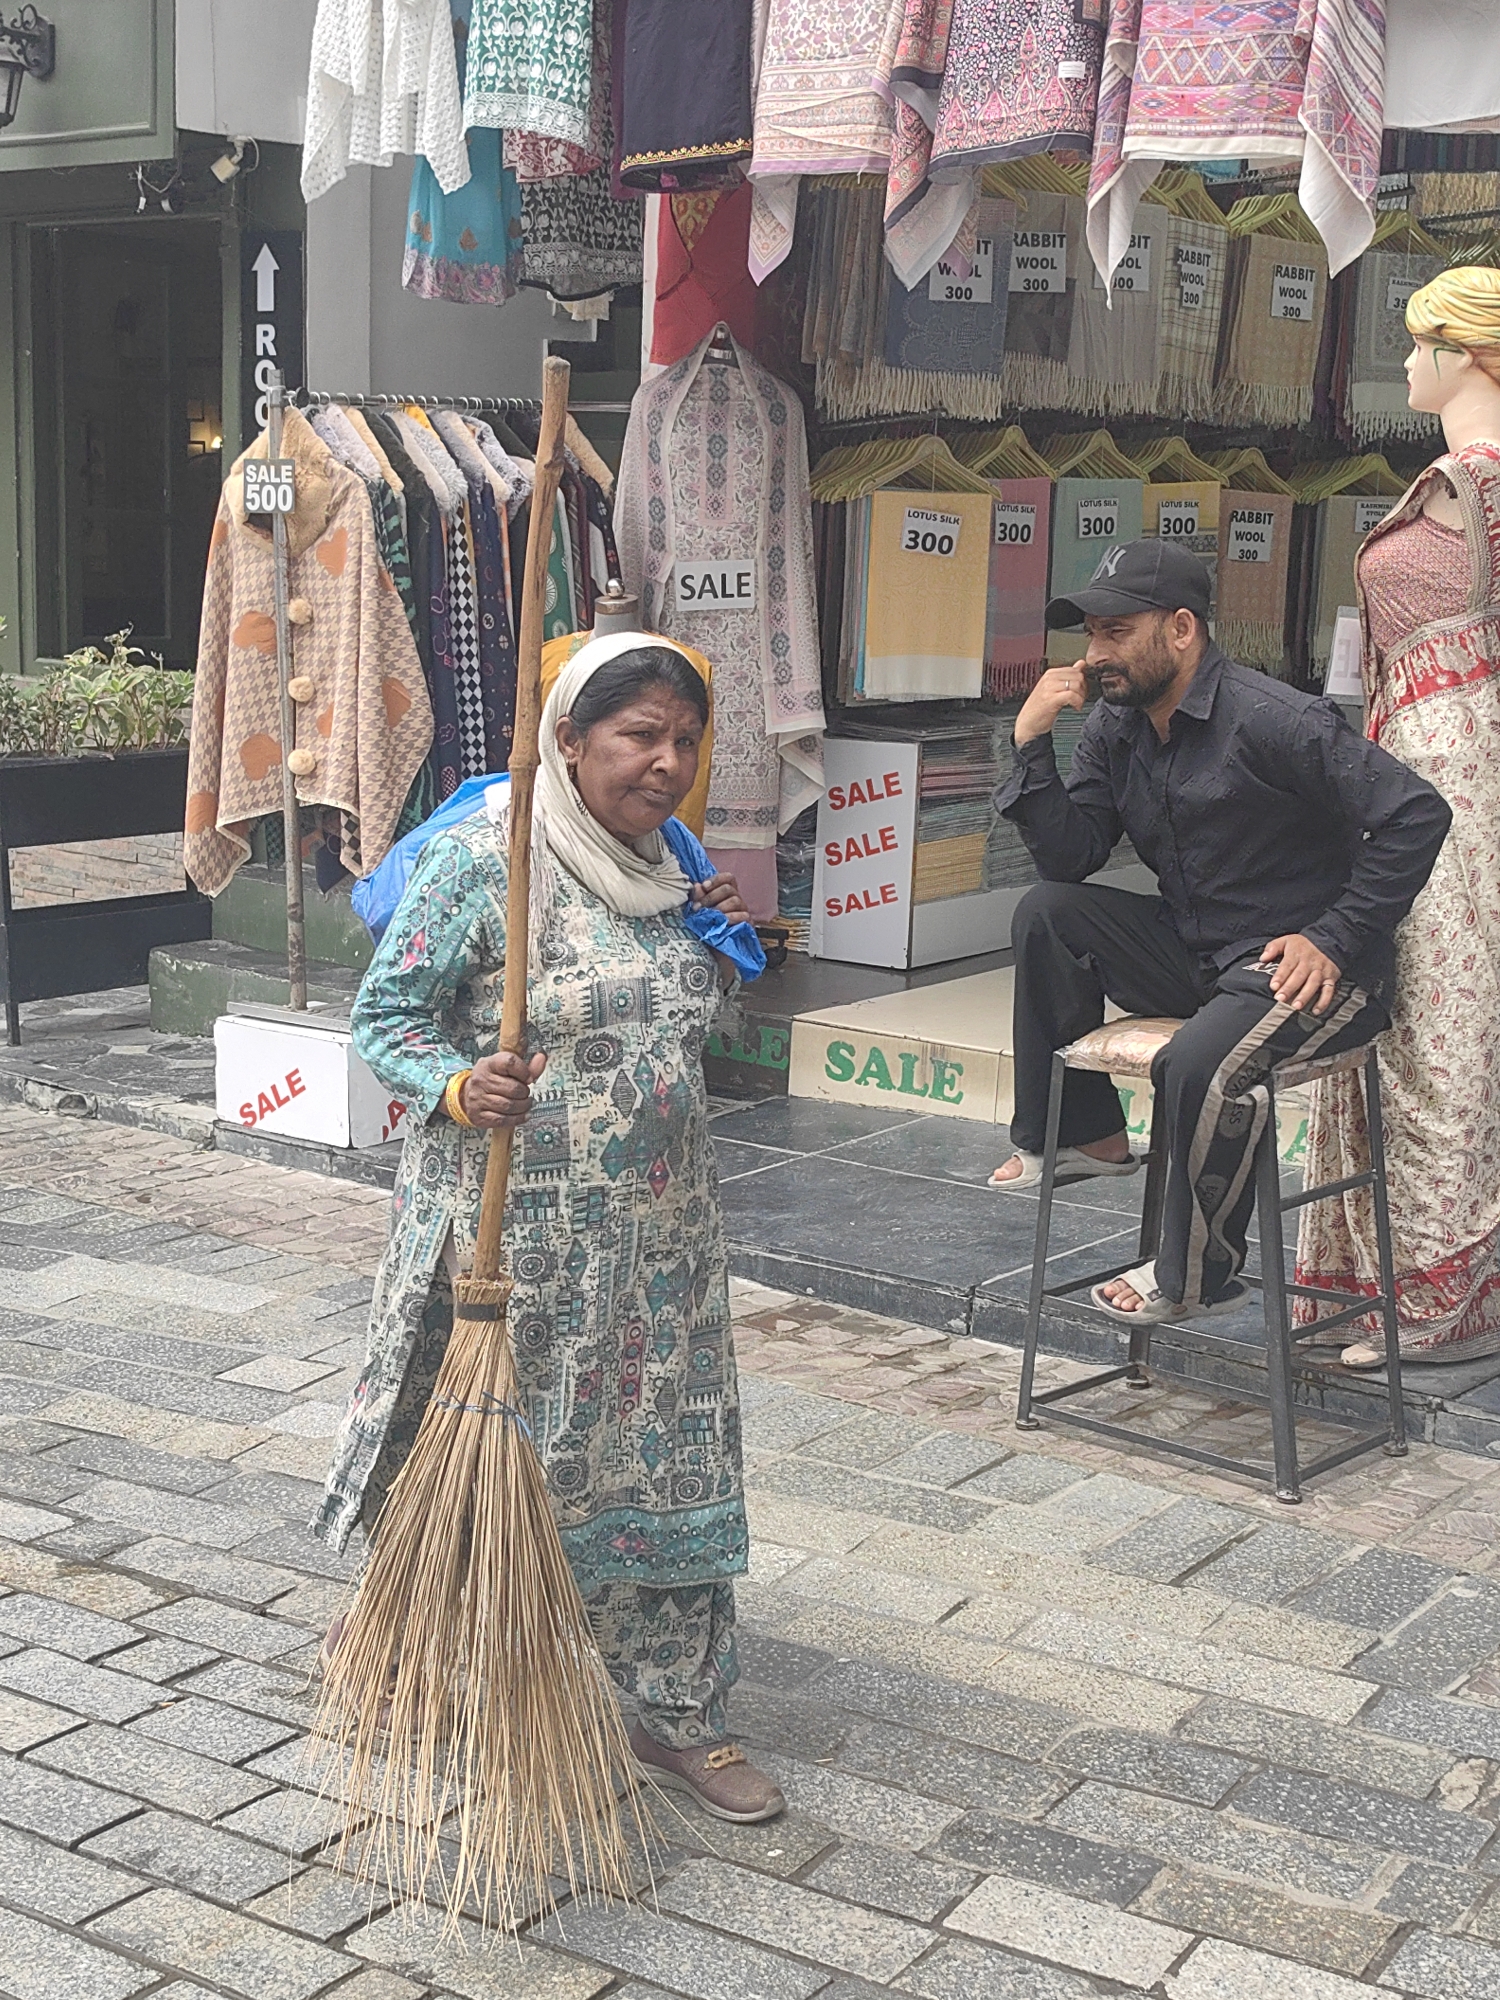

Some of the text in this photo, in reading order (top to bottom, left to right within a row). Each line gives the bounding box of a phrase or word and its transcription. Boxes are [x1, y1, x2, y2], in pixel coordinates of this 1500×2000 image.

[1016, 257, 1058, 270] WOOL
[1117, 257, 1142, 269] OOL
[1178, 248, 1211, 267] RABBIT
[1181, 272, 1205, 286] WOOL
[1275, 264, 1316, 282] RABBIT
[1023, 278, 1049, 291] 300
[945, 286, 973, 300] 300
[1184, 292, 1200, 305] 300
[1279, 286, 1308, 300] WOOL
[1393, 297, 1408, 309] 35
[1282, 306, 1301, 318] 300
[246, 464, 293, 483] SALE
[245, 484, 293, 512] 500
[1080, 500, 1102, 508] LOTUS
[997, 504, 1036, 514] LOTUS SILK
[907, 510, 960, 525] LOTUS SILK
[1231, 510, 1274, 525] RABBIT
[997, 522, 1032, 543] 300
[1082, 517, 1115, 535] 300
[1162, 517, 1196, 535] 300
[904, 529, 954, 555] 300
[1235, 530, 1266, 543] WOOL
[1238, 549, 1258, 560] 300
[680, 572, 752, 600] SALE
[828, 772, 903, 811] SALE
[824, 826, 899, 866] SALE
[825, 883, 899, 917] SALE
[825, 1040, 965, 1106] SALE
[239, 1068, 307, 1128] SALE
